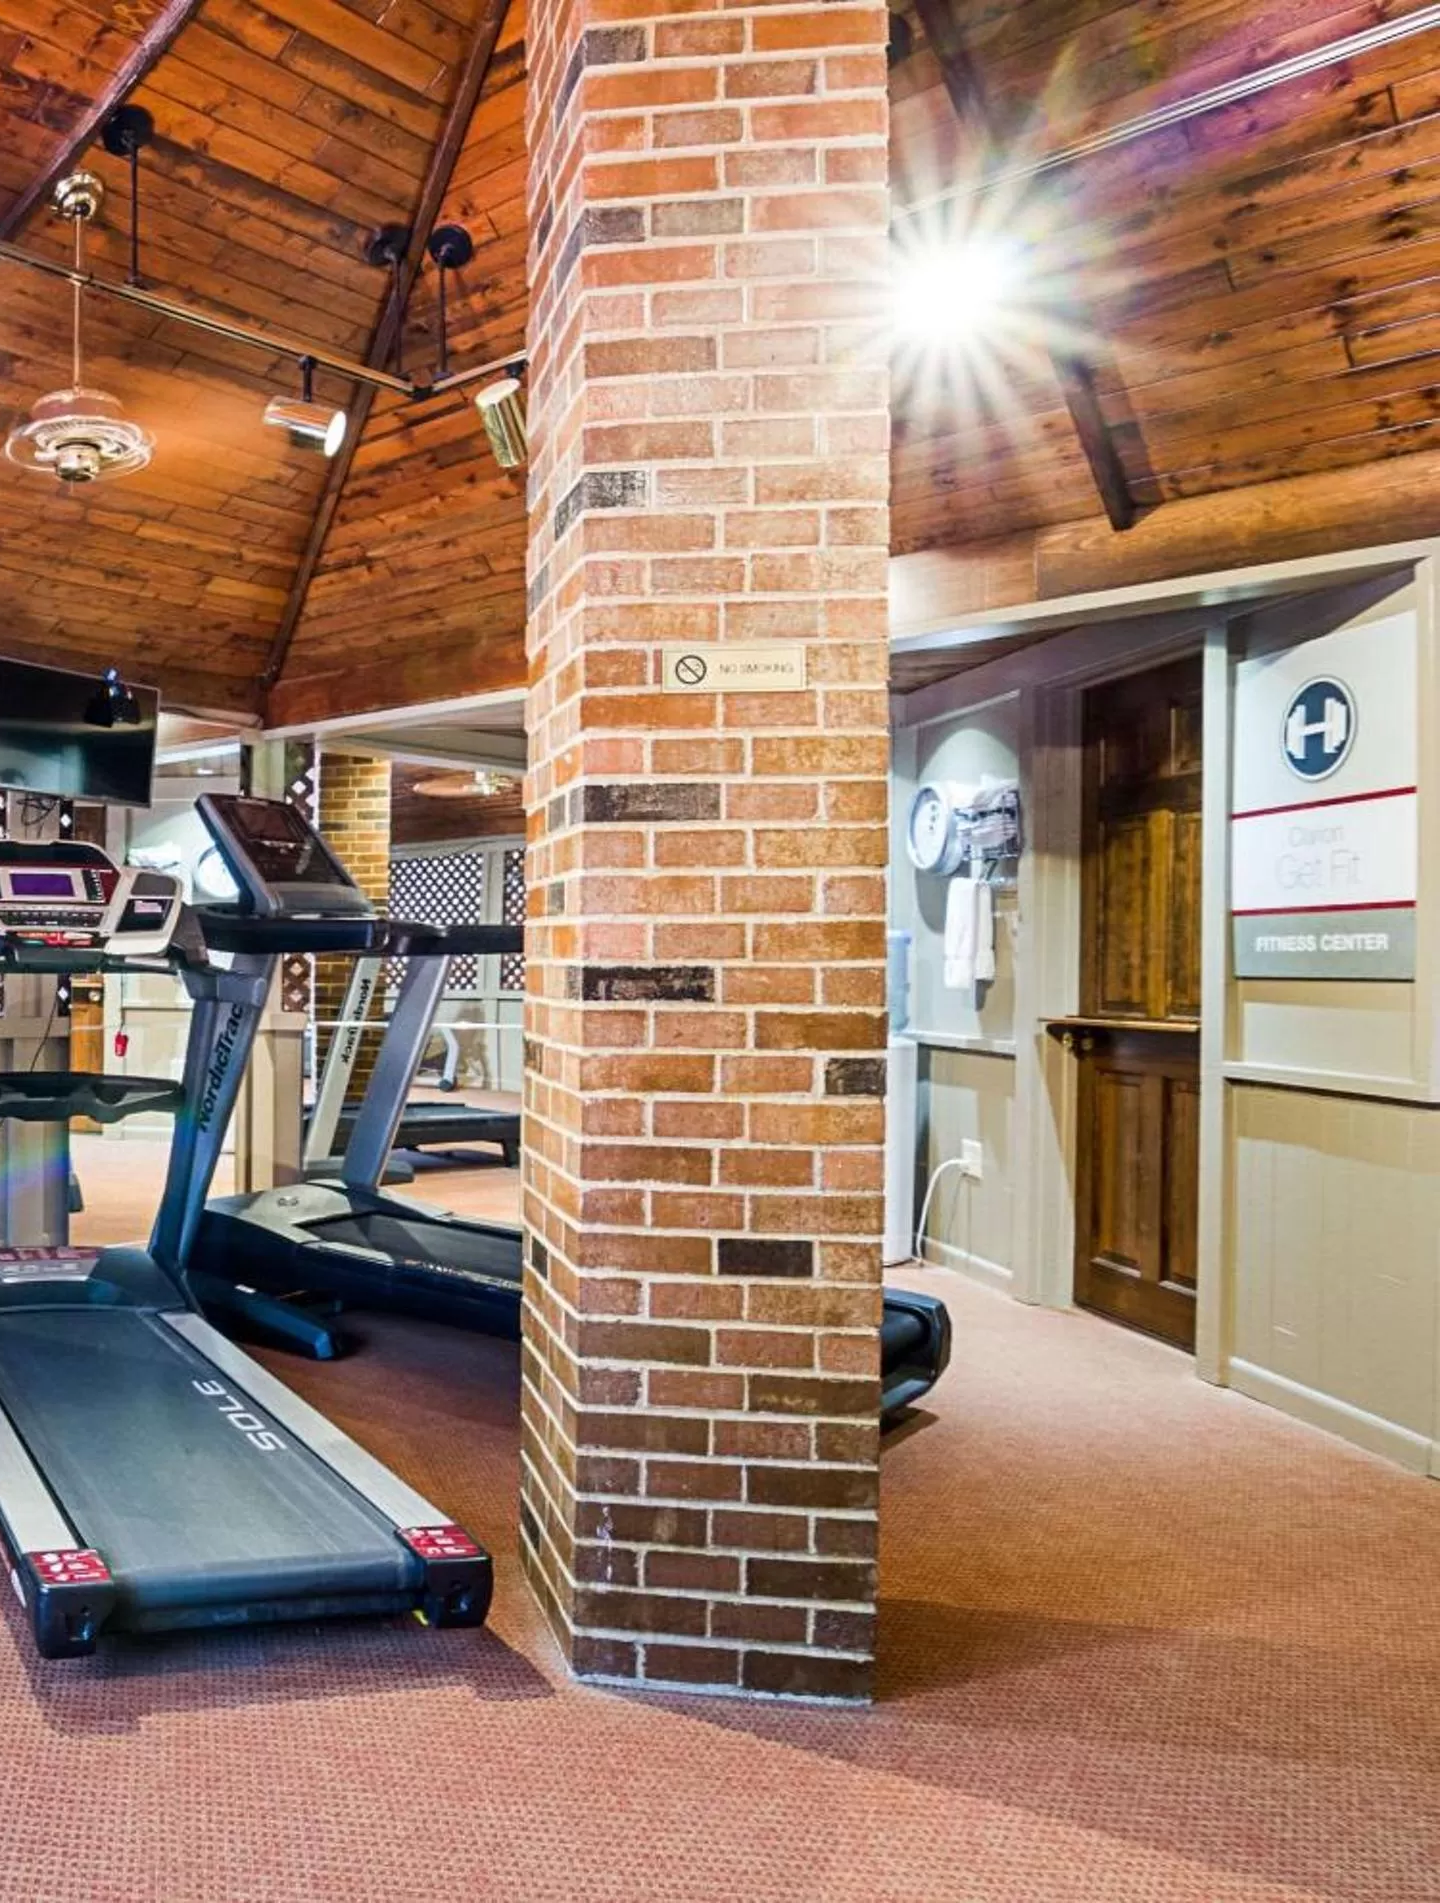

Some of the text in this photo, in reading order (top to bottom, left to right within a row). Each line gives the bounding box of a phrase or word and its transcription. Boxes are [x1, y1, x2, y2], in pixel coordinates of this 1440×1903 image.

[719, 663, 737, 674] NO
[1256, 933, 1389, 952] FITNESS CENTER
[198, 1003, 244, 1133] NordicTrac
